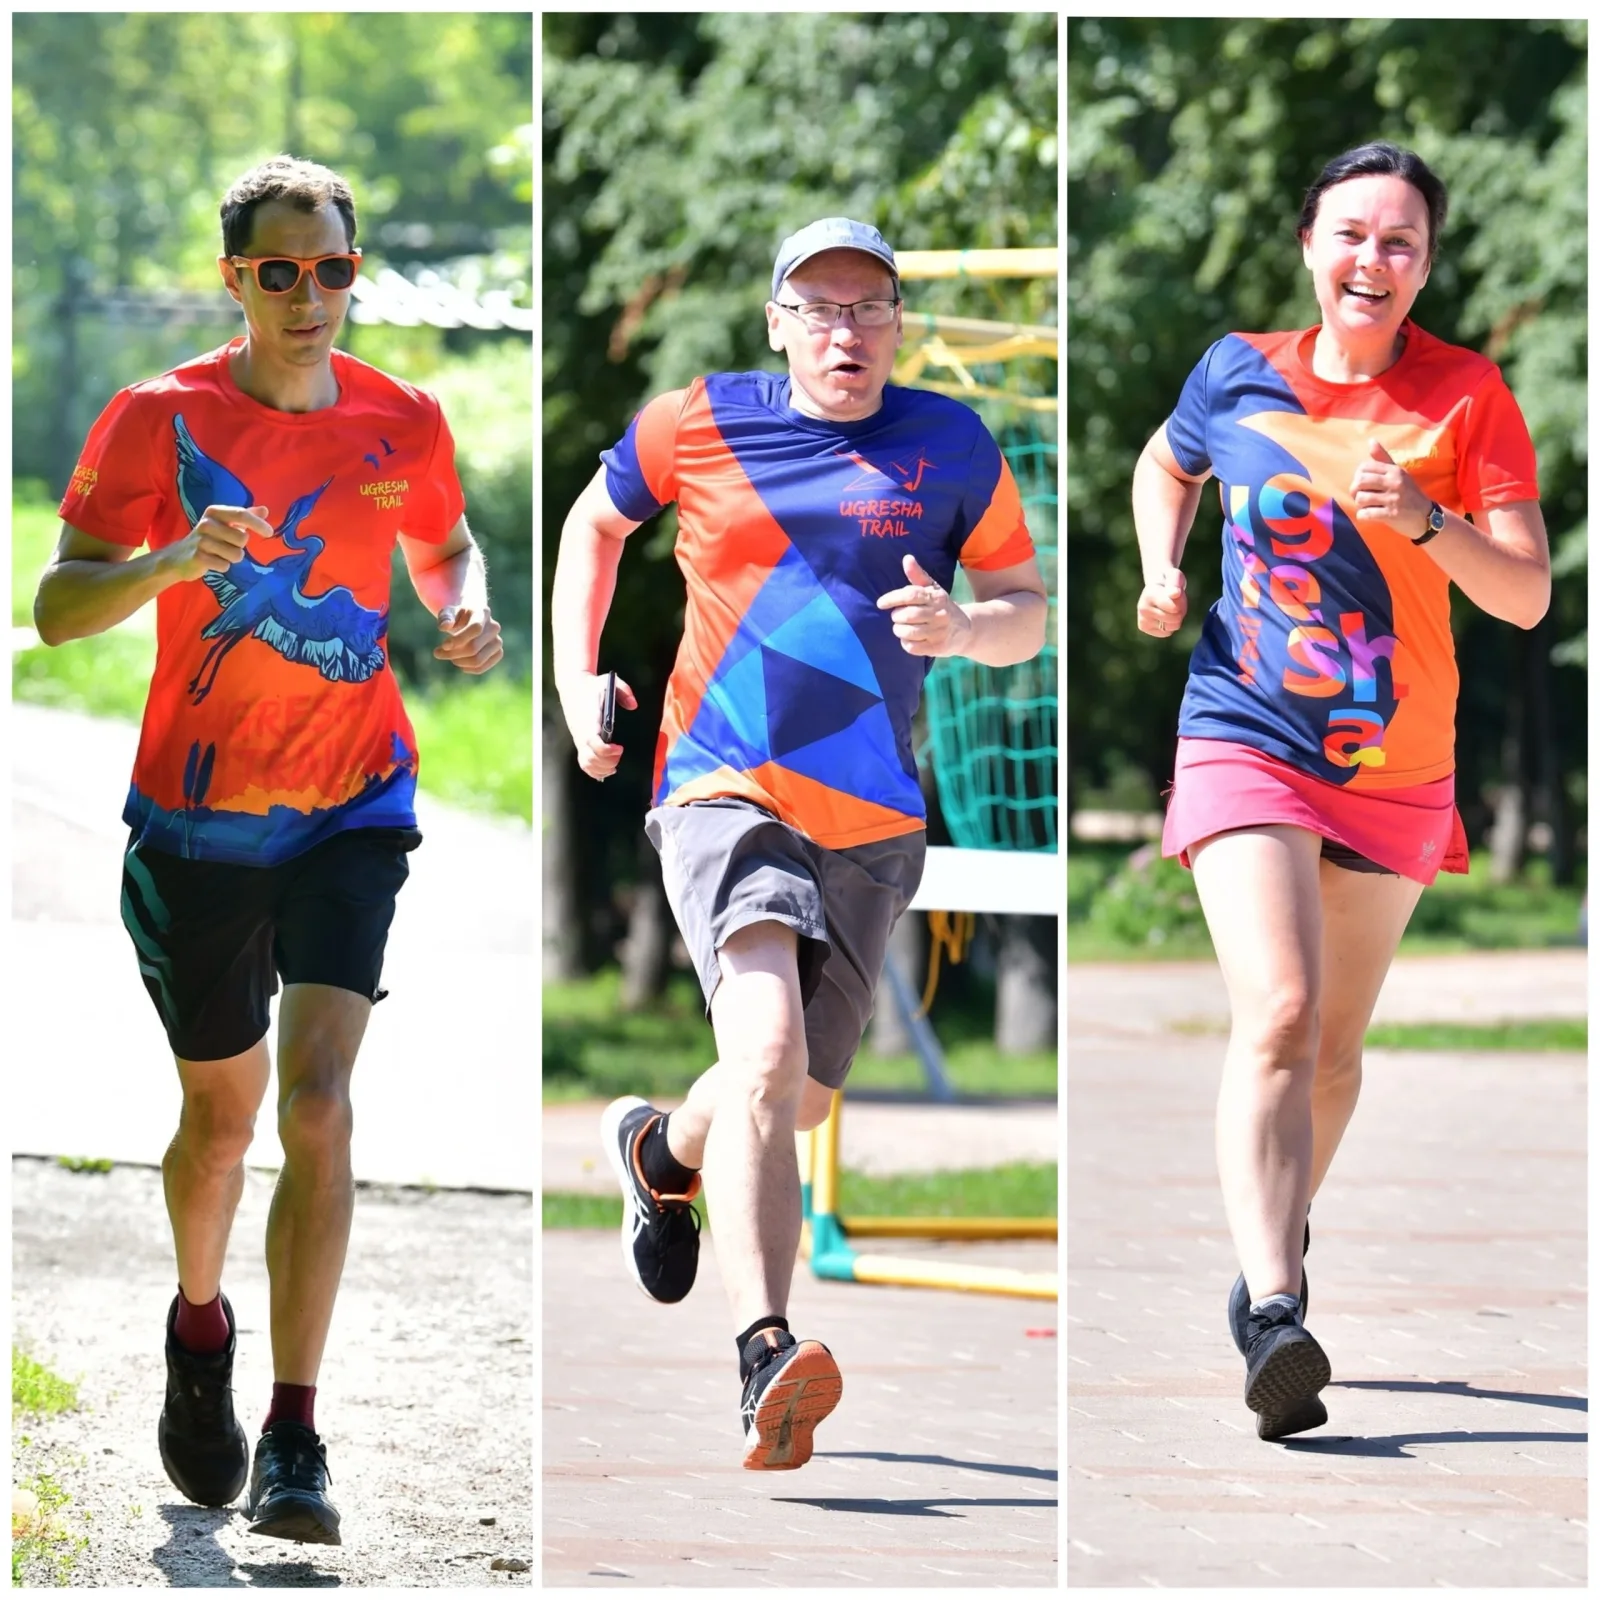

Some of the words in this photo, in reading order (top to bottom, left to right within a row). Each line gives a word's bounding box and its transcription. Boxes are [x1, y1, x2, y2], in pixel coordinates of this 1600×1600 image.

[360, 480, 409, 496] UGRESHA
[373, 495, 403, 511] TRAIL
[840, 500, 923, 519] UGRESHA
[858, 519, 910, 538] TRAIL
